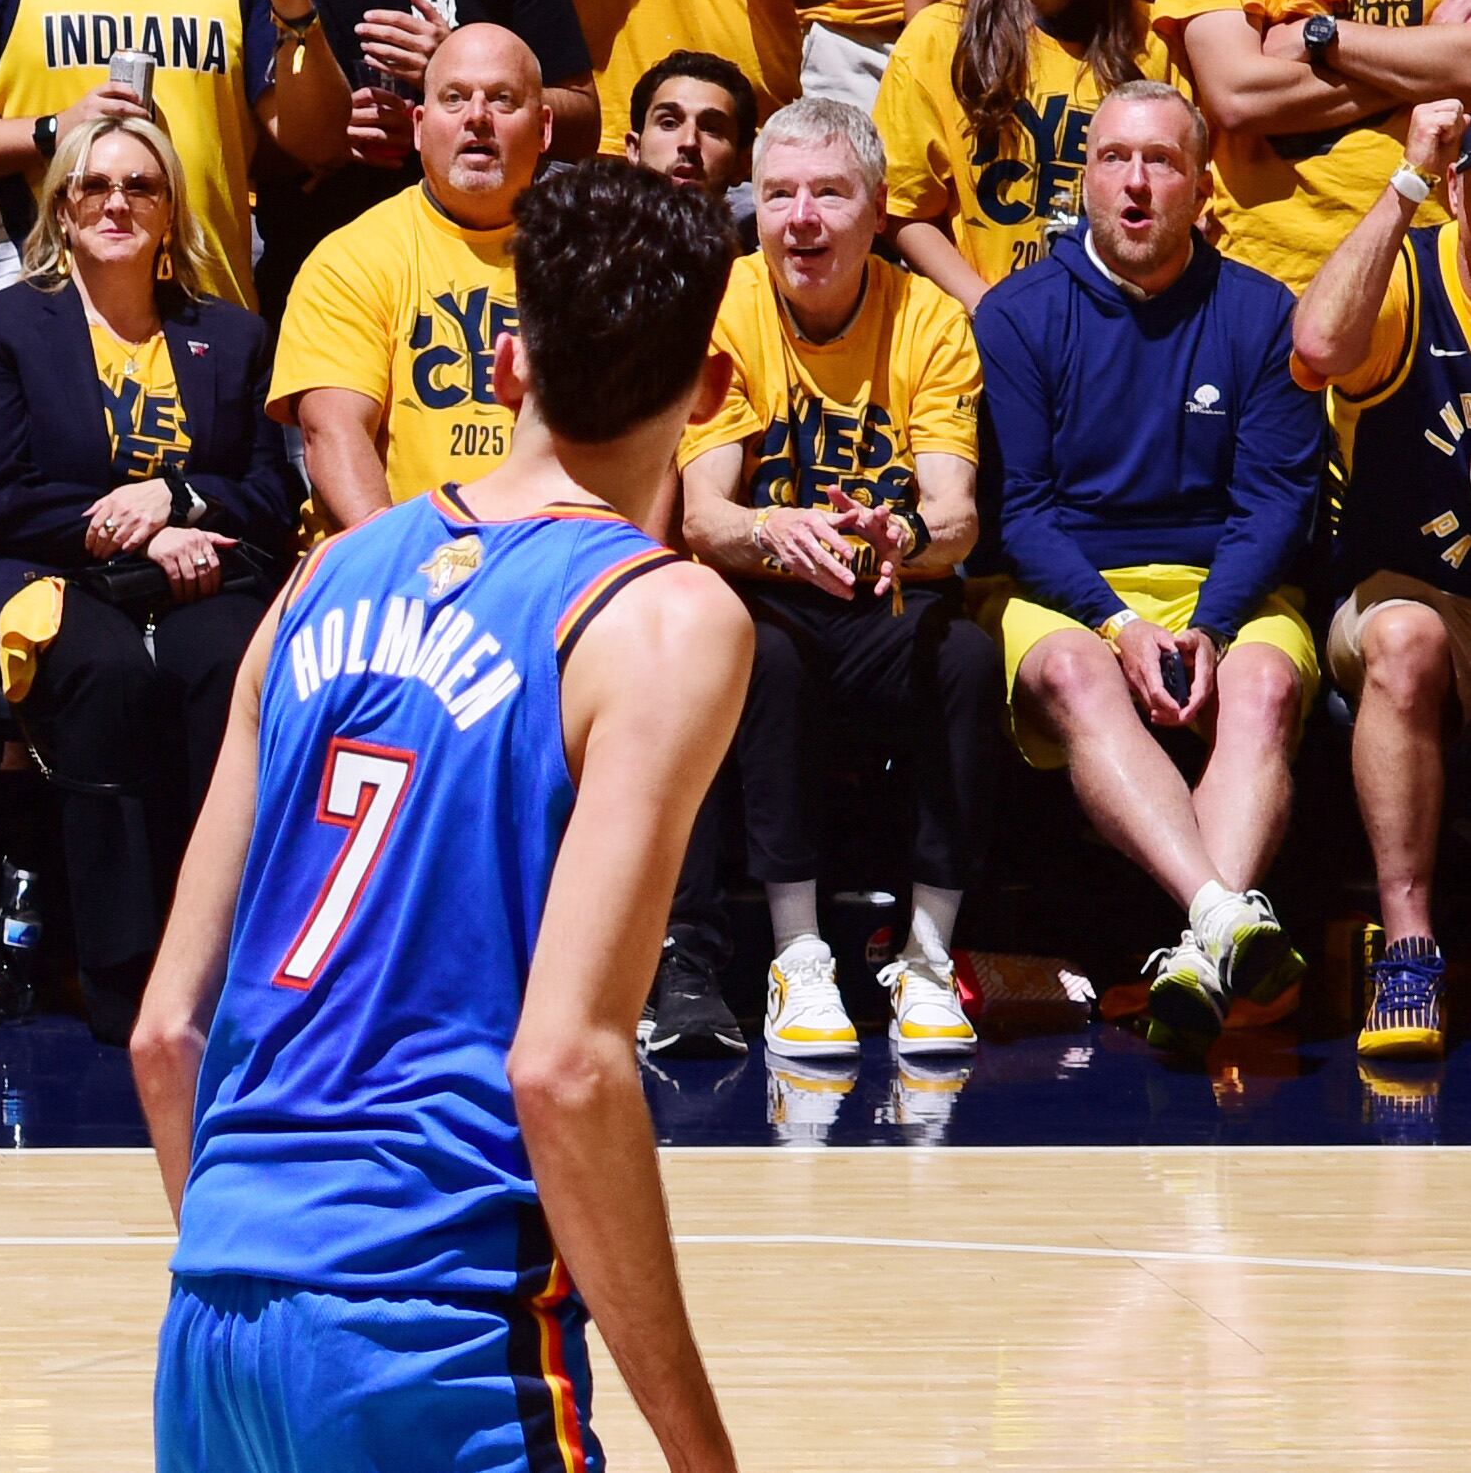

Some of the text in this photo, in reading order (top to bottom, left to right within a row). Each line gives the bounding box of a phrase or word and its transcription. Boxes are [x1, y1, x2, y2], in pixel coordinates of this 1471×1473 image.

[44, 13, 227, 75] INDIANA
[451, 423, 506, 457] 2025
[289, 596, 522, 732] HOLMGREN
[271, 736, 417, 992] 7
